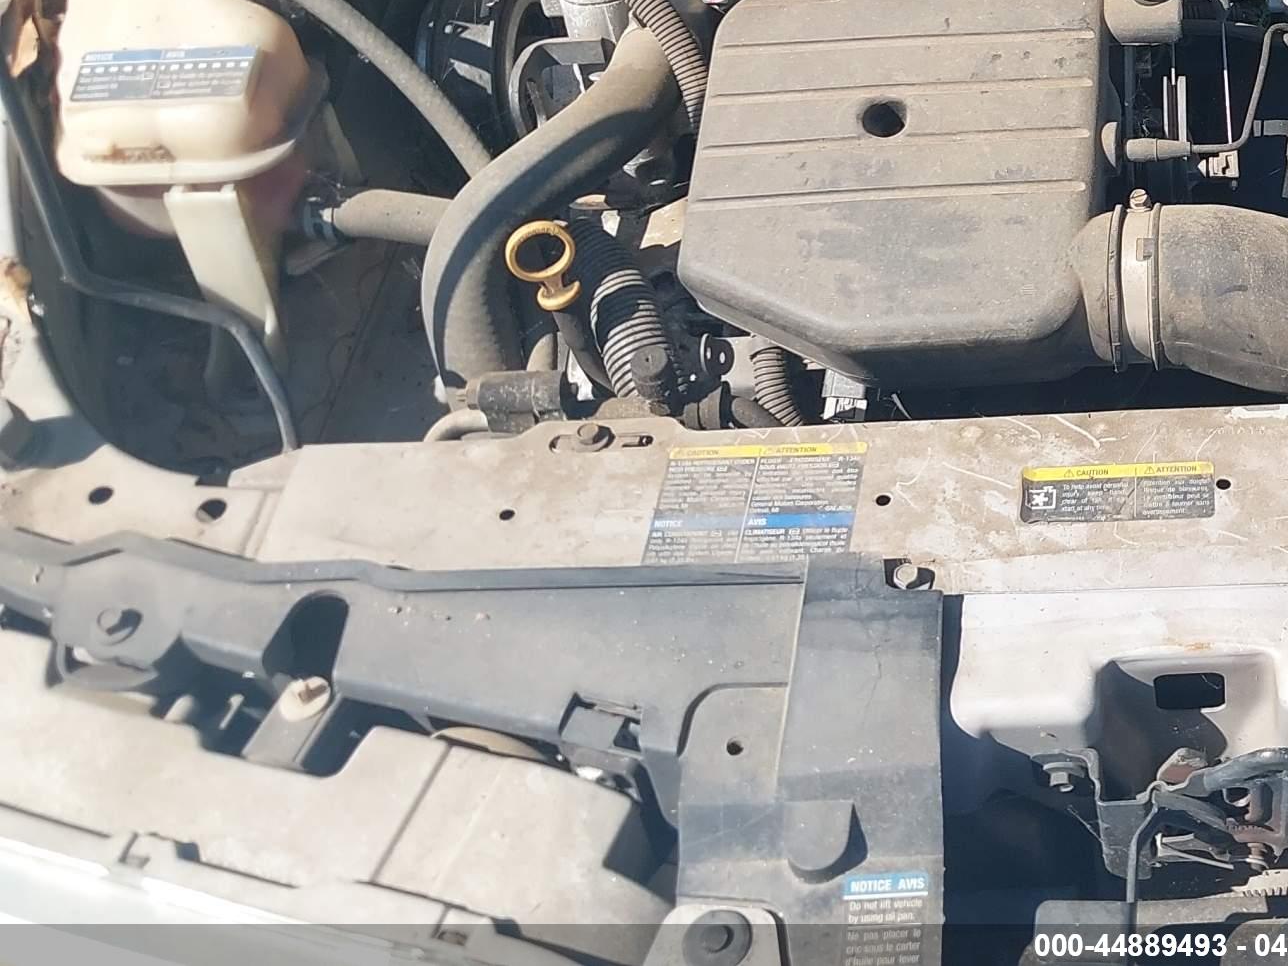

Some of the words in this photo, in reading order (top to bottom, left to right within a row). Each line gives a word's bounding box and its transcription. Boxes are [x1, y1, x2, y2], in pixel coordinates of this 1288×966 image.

[851, 879, 892, 892] NOTICE
[898, 877, 925, 890] AVIS
[849, 902, 861, 911] Do
[864, 901, 878, 910] not
[880, 899, 891, 909] lift
[894, 898, 923, 908] vehicle
[848, 914, 859, 924] by
[861, 913, 884, 923] using
[886, 912, 896, 921] oil
[897, 913, 914, 922] pan.
[848, 931, 859, 940] Ne
[864, 931, 878, 941] pas
[883, 929, 908, 940] placer
[913, 928, 921, 937] le
[846, 945, 862, 954] cric
[864, 944, 884, 953] sous
[886, 942, 894, 952] le
[896, 941, 920, 952] carter
[877, 956, 896, 966] pour
[899, 954, 920, 964] lever
